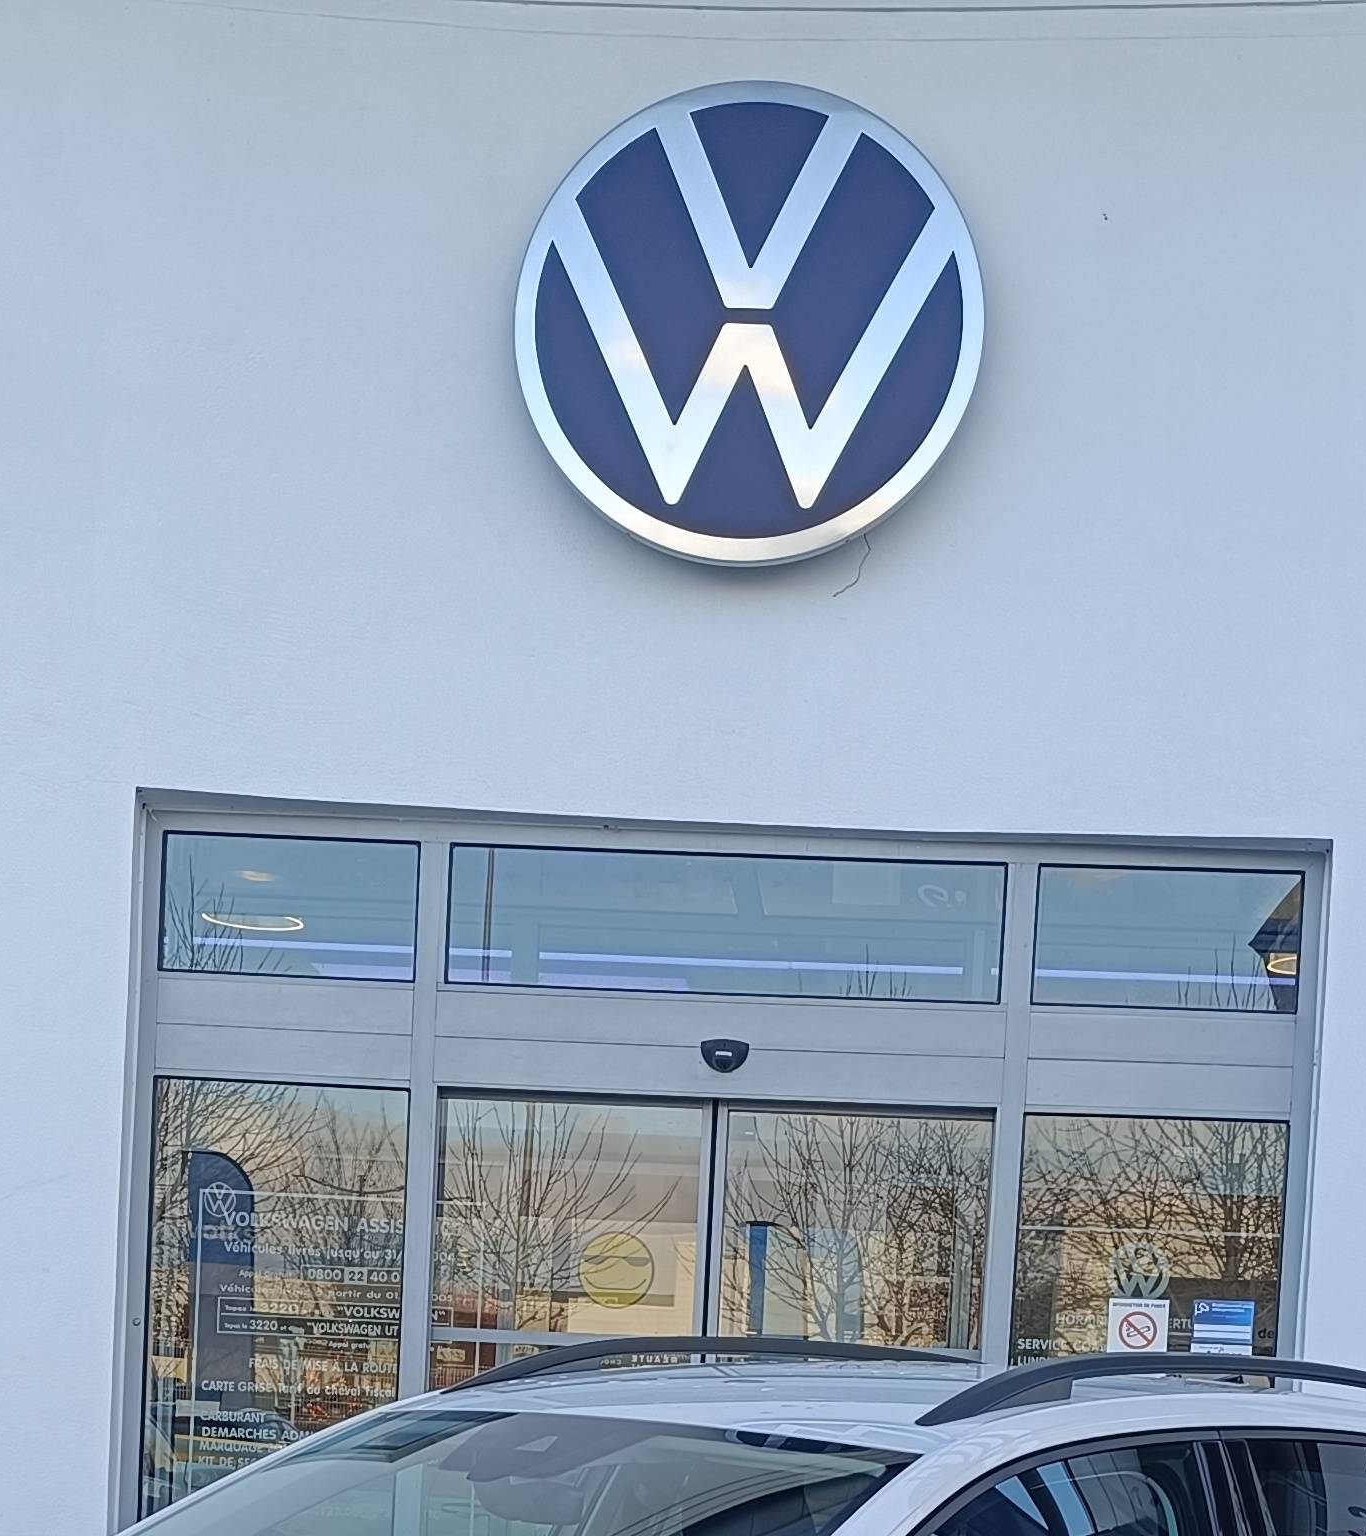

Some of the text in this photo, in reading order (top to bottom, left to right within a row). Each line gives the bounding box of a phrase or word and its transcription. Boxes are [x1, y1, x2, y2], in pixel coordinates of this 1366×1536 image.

[224, 1211, 348, 1232] VOLKSWAGEN
[224, 1241, 283, 1255] Véhicules
[288, 1245, 321, 1257] livrés
[326, 1247, 380, 1260] jusqu'au
[307, 1268, 342, 1281] 0800
[348, 1271, 365, 1281] 22
[369, 1271, 388, 1283] 40
[366, 1290, 381, 1299] du
[249, 1320, 278, 1331] 3220
[384, 1325, 399, 1336] UT
[1017, 1338, 1067, 1350] SERVICE
[248, 1358, 278, 1370] FRAIS
[283, 1359, 298, 1371] DE
[303, 1360, 328, 1372] MISE
[345, 1362, 358, 1373] LA
[362, 1363, 397, 1374] ROUTE
[201, 1380, 235, 1392] CARTE
[237, 1381, 272, 1393] GRISE
[364, 1385, 396, 1398] fiscal
[200, 1411, 266, 1423] CARBURANT
[201, 1427, 277, 1440] DEMARCHES
[219, 1456, 234, 1467] DE
